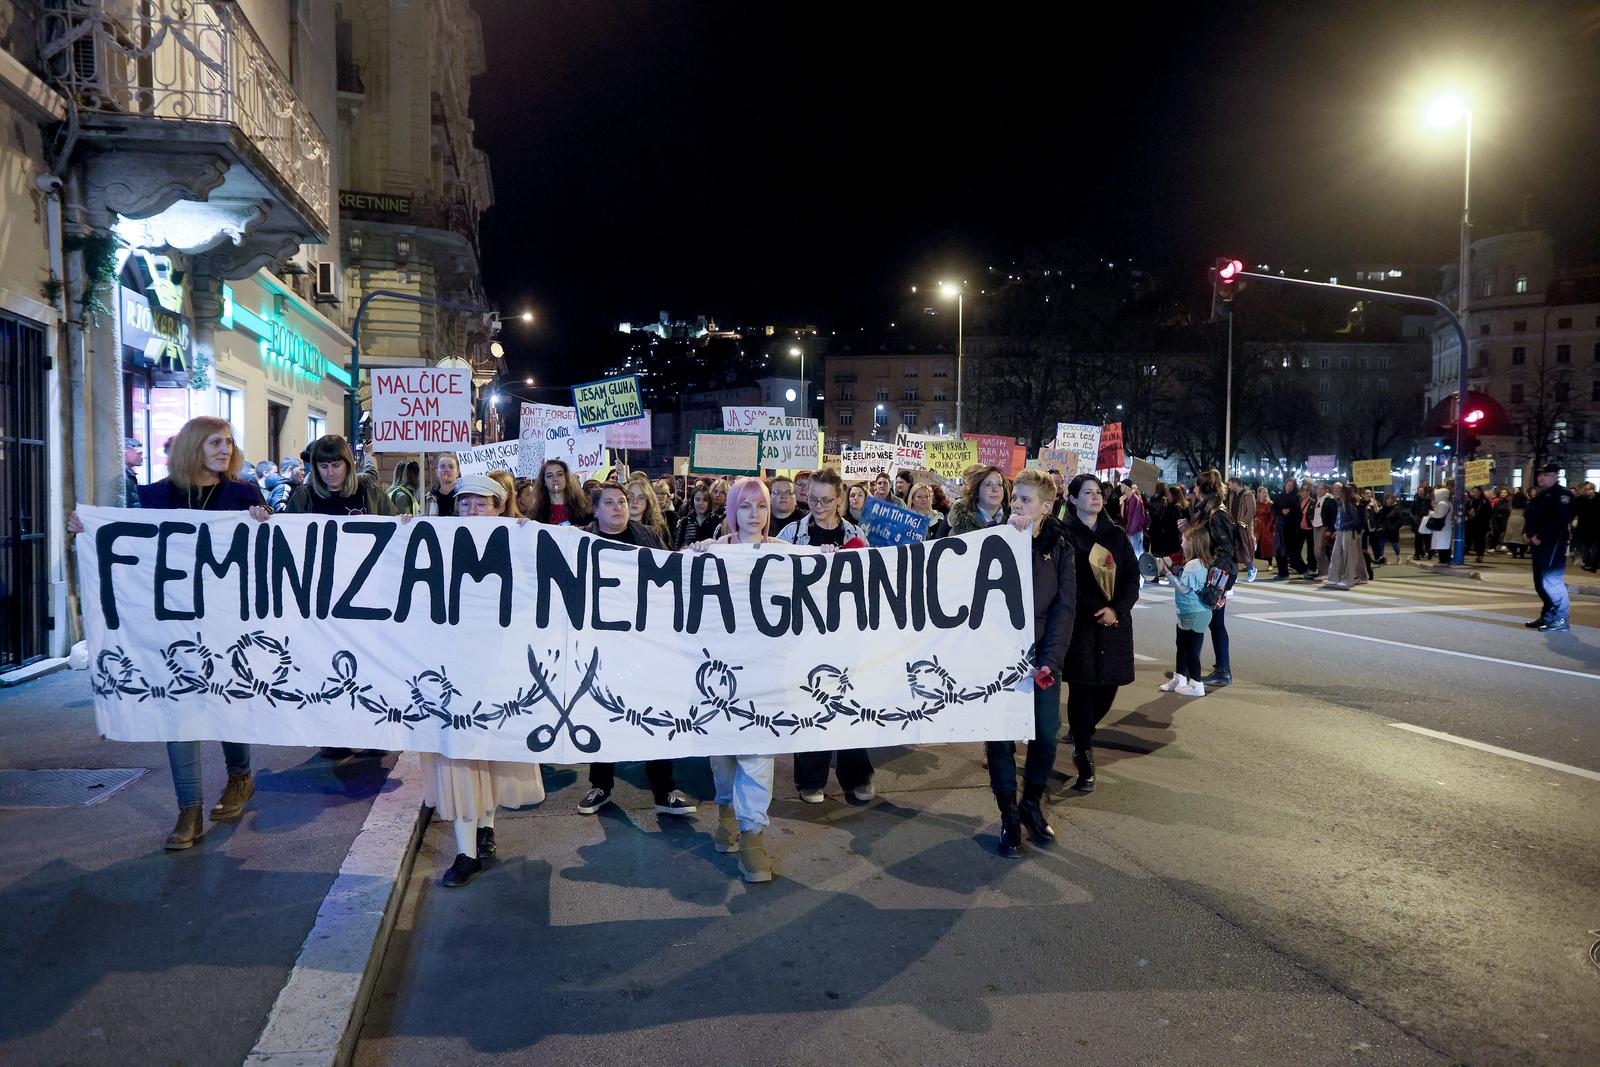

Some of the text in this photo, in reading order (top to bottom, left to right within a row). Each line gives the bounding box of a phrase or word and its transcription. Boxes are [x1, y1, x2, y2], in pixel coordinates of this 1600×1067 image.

[377, 370, 463, 395] MALČICE
[578, 380, 637, 402] JESAM GLUHA
[398, 397, 440, 417] SAM
[604, 396, 616, 407] ALI
[579, 405, 609, 424] NISAM
[612, 400, 641, 418] GLUPA
[726, 409, 741, 427] JA
[768, 416, 784, 426] ZA
[373, 420, 470, 443] UZNEMIRENA
[1079, 431, 1096, 442] test
[458, 452, 474, 466] AKO
[474, 447, 497, 463] NISAM
[761, 445, 780, 459] KAD
[842, 452, 852, 461] NE
[486, 459, 509, 471] DOMA
[871, 502, 890, 518] RIM
[96, 520, 1026, 638] FEMINIZAM NEMA GRANICA
